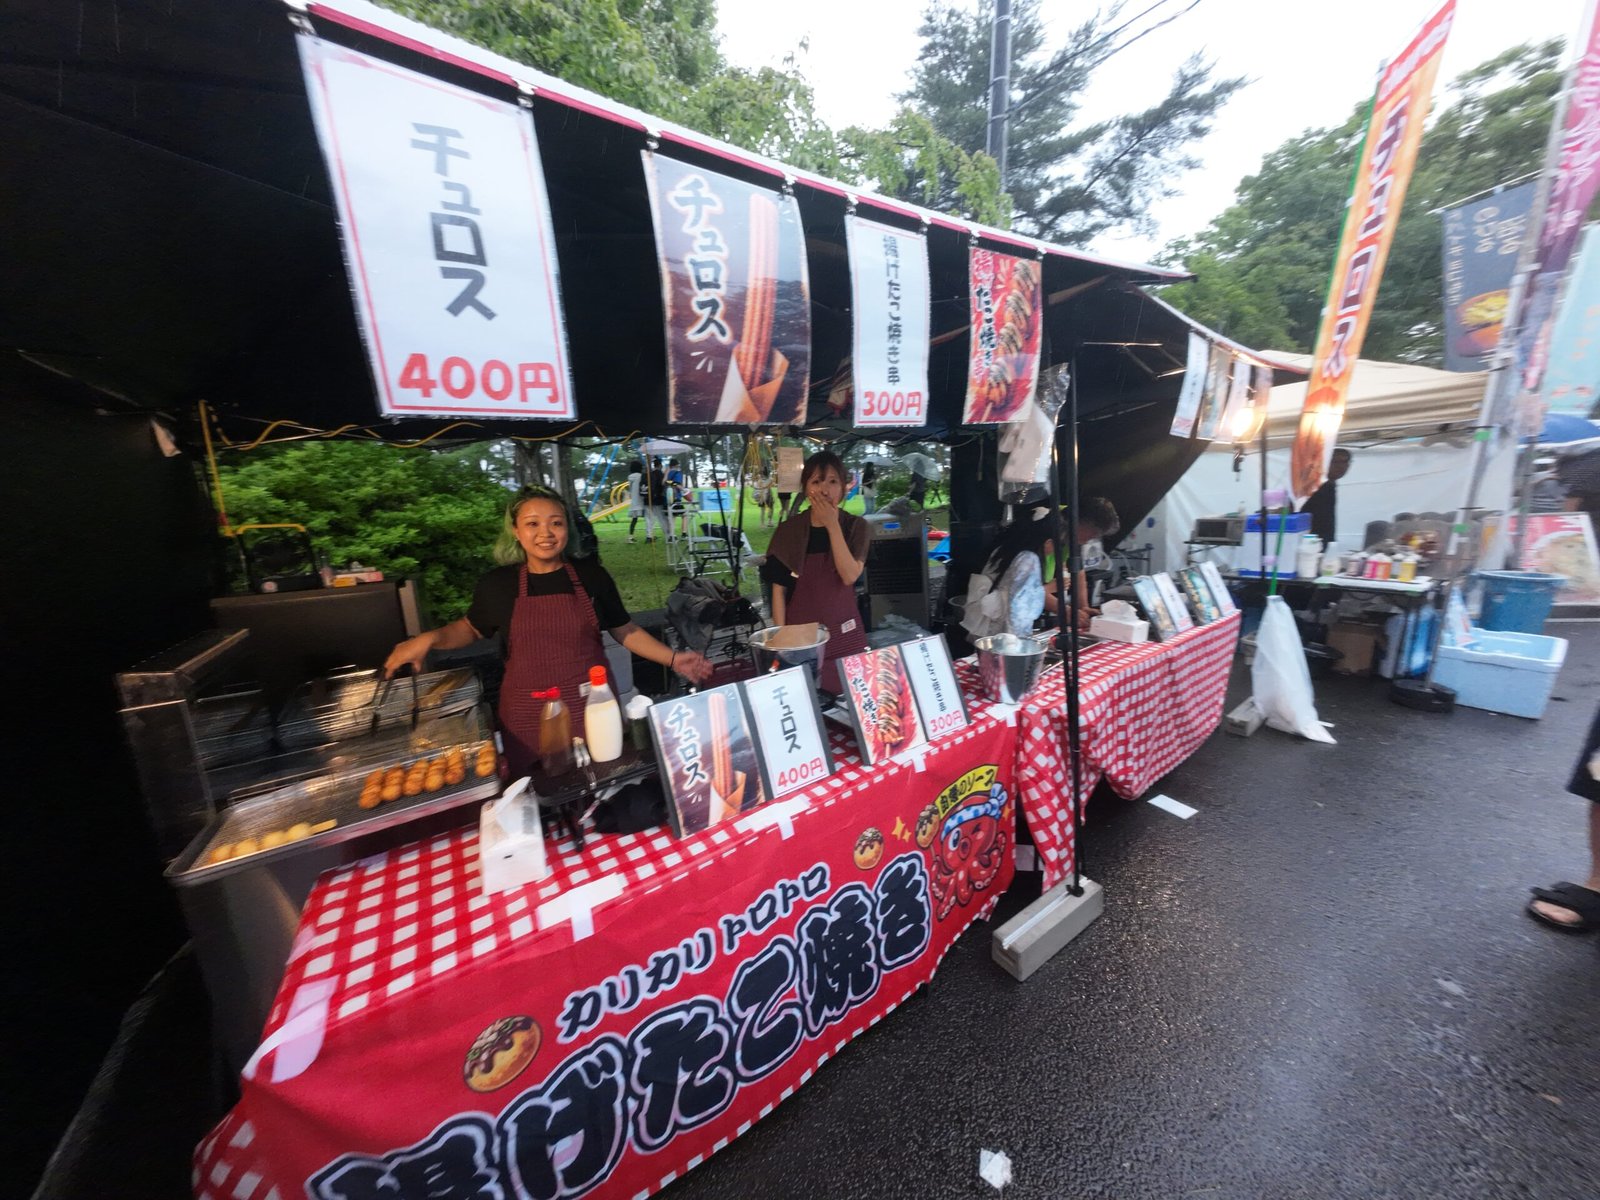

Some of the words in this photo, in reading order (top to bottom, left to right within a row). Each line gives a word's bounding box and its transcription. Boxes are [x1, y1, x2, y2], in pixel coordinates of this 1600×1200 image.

[410, 121, 498, 322] チュロス
[668, 175, 731, 343] チュロス
[398, 352, 560, 404] 400円
[862, 391, 922, 417] 300円
[666, 702, 709, 792] チュロス
[771, 685, 801, 754] チュロス
[930, 710, 964, 733] 300円
[777, 756, 825, 788] 400円
